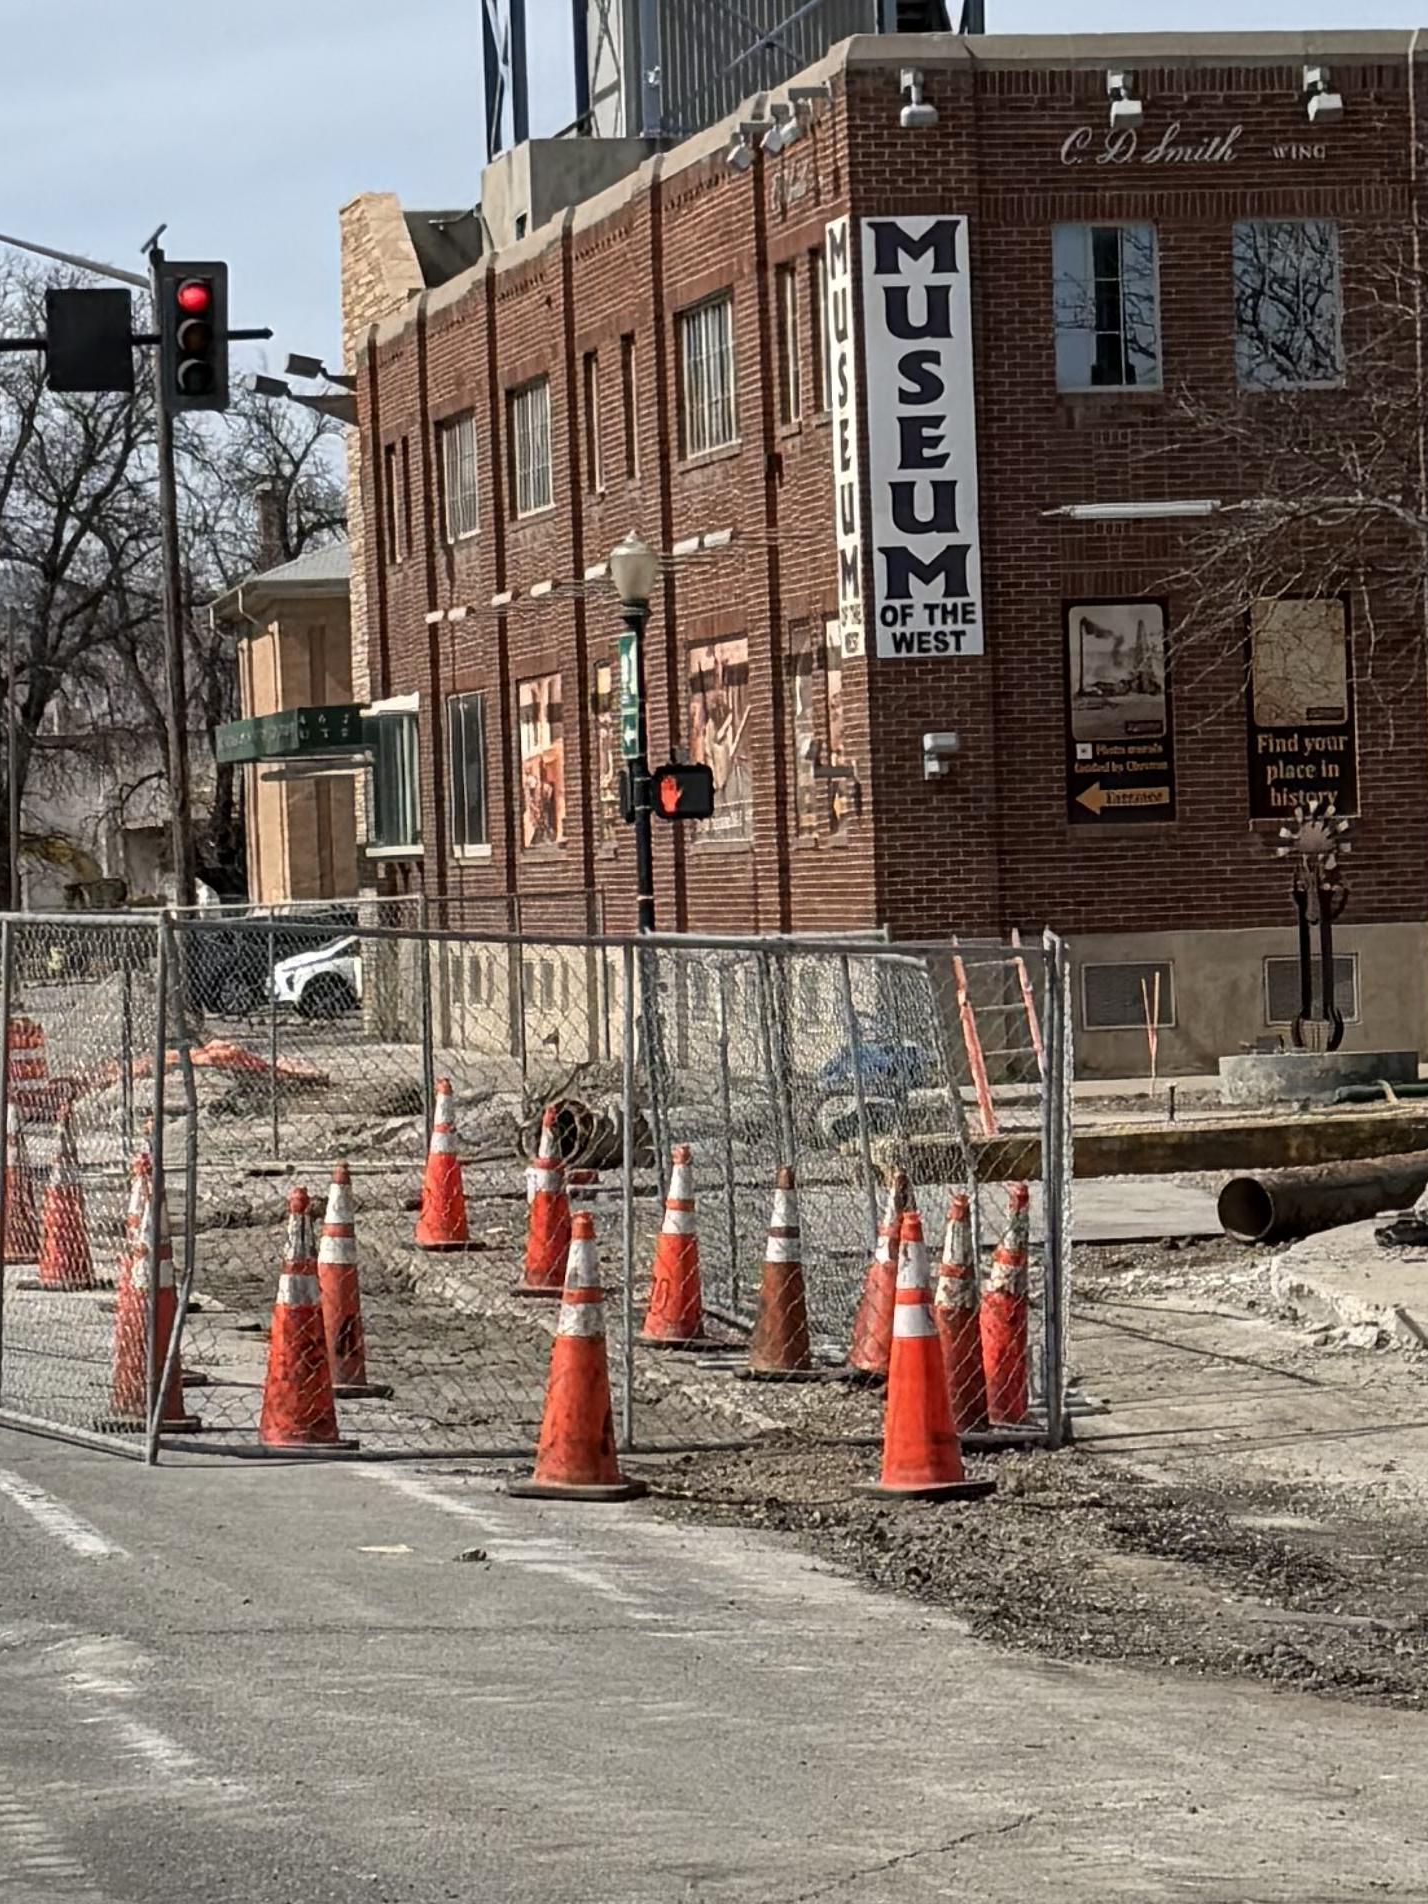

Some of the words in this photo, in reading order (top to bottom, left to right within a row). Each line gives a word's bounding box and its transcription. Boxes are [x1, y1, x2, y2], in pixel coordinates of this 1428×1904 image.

[1141, 120, 1243, 164] Smith
[1270, 144, 1326, 160] WING
[829, 221, 860, 602] MUSEUM
[866, 219, 972, 600] MUSEUM
[880, 603, 914, 628] OF
[923, 602, 976, 627] THE
[891, 629, 967, 655] WEST
[1256, 733, 1299, 754] Find
[1303, 735, 1348, 757] your
[1266, 760, 1317, 786] place
[1320, 759, 1341, 778] in
[1270, 786, 1339, 807] history
